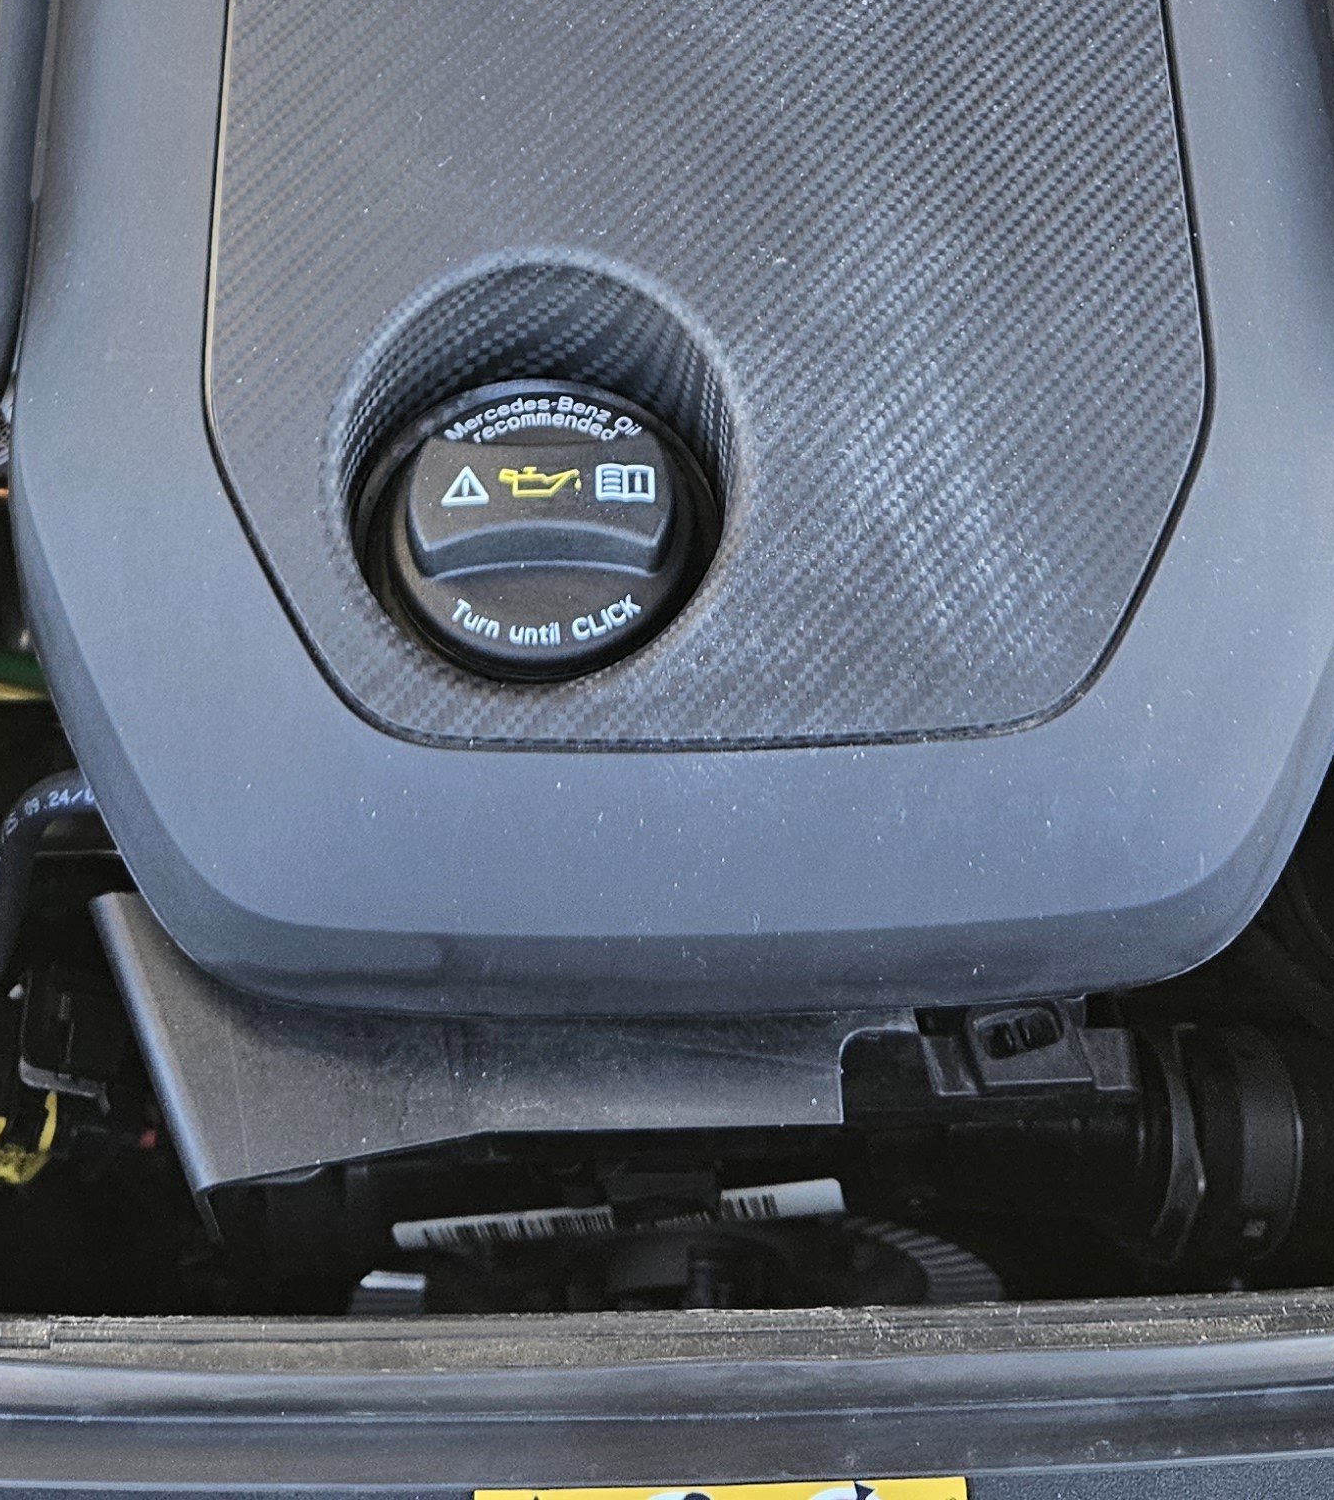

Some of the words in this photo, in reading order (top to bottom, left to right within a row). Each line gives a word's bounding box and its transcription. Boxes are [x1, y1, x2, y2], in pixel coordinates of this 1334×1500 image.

[444, 396, 612, 440] Mercedes-Benz
[614, 416, 643, 436] Oil
[472, 412, 619, 443] recommended
[451, 598, 500, 640] Turn
[509, 621, 561, 646] until
[571, 594, 642, 641] CLICK
